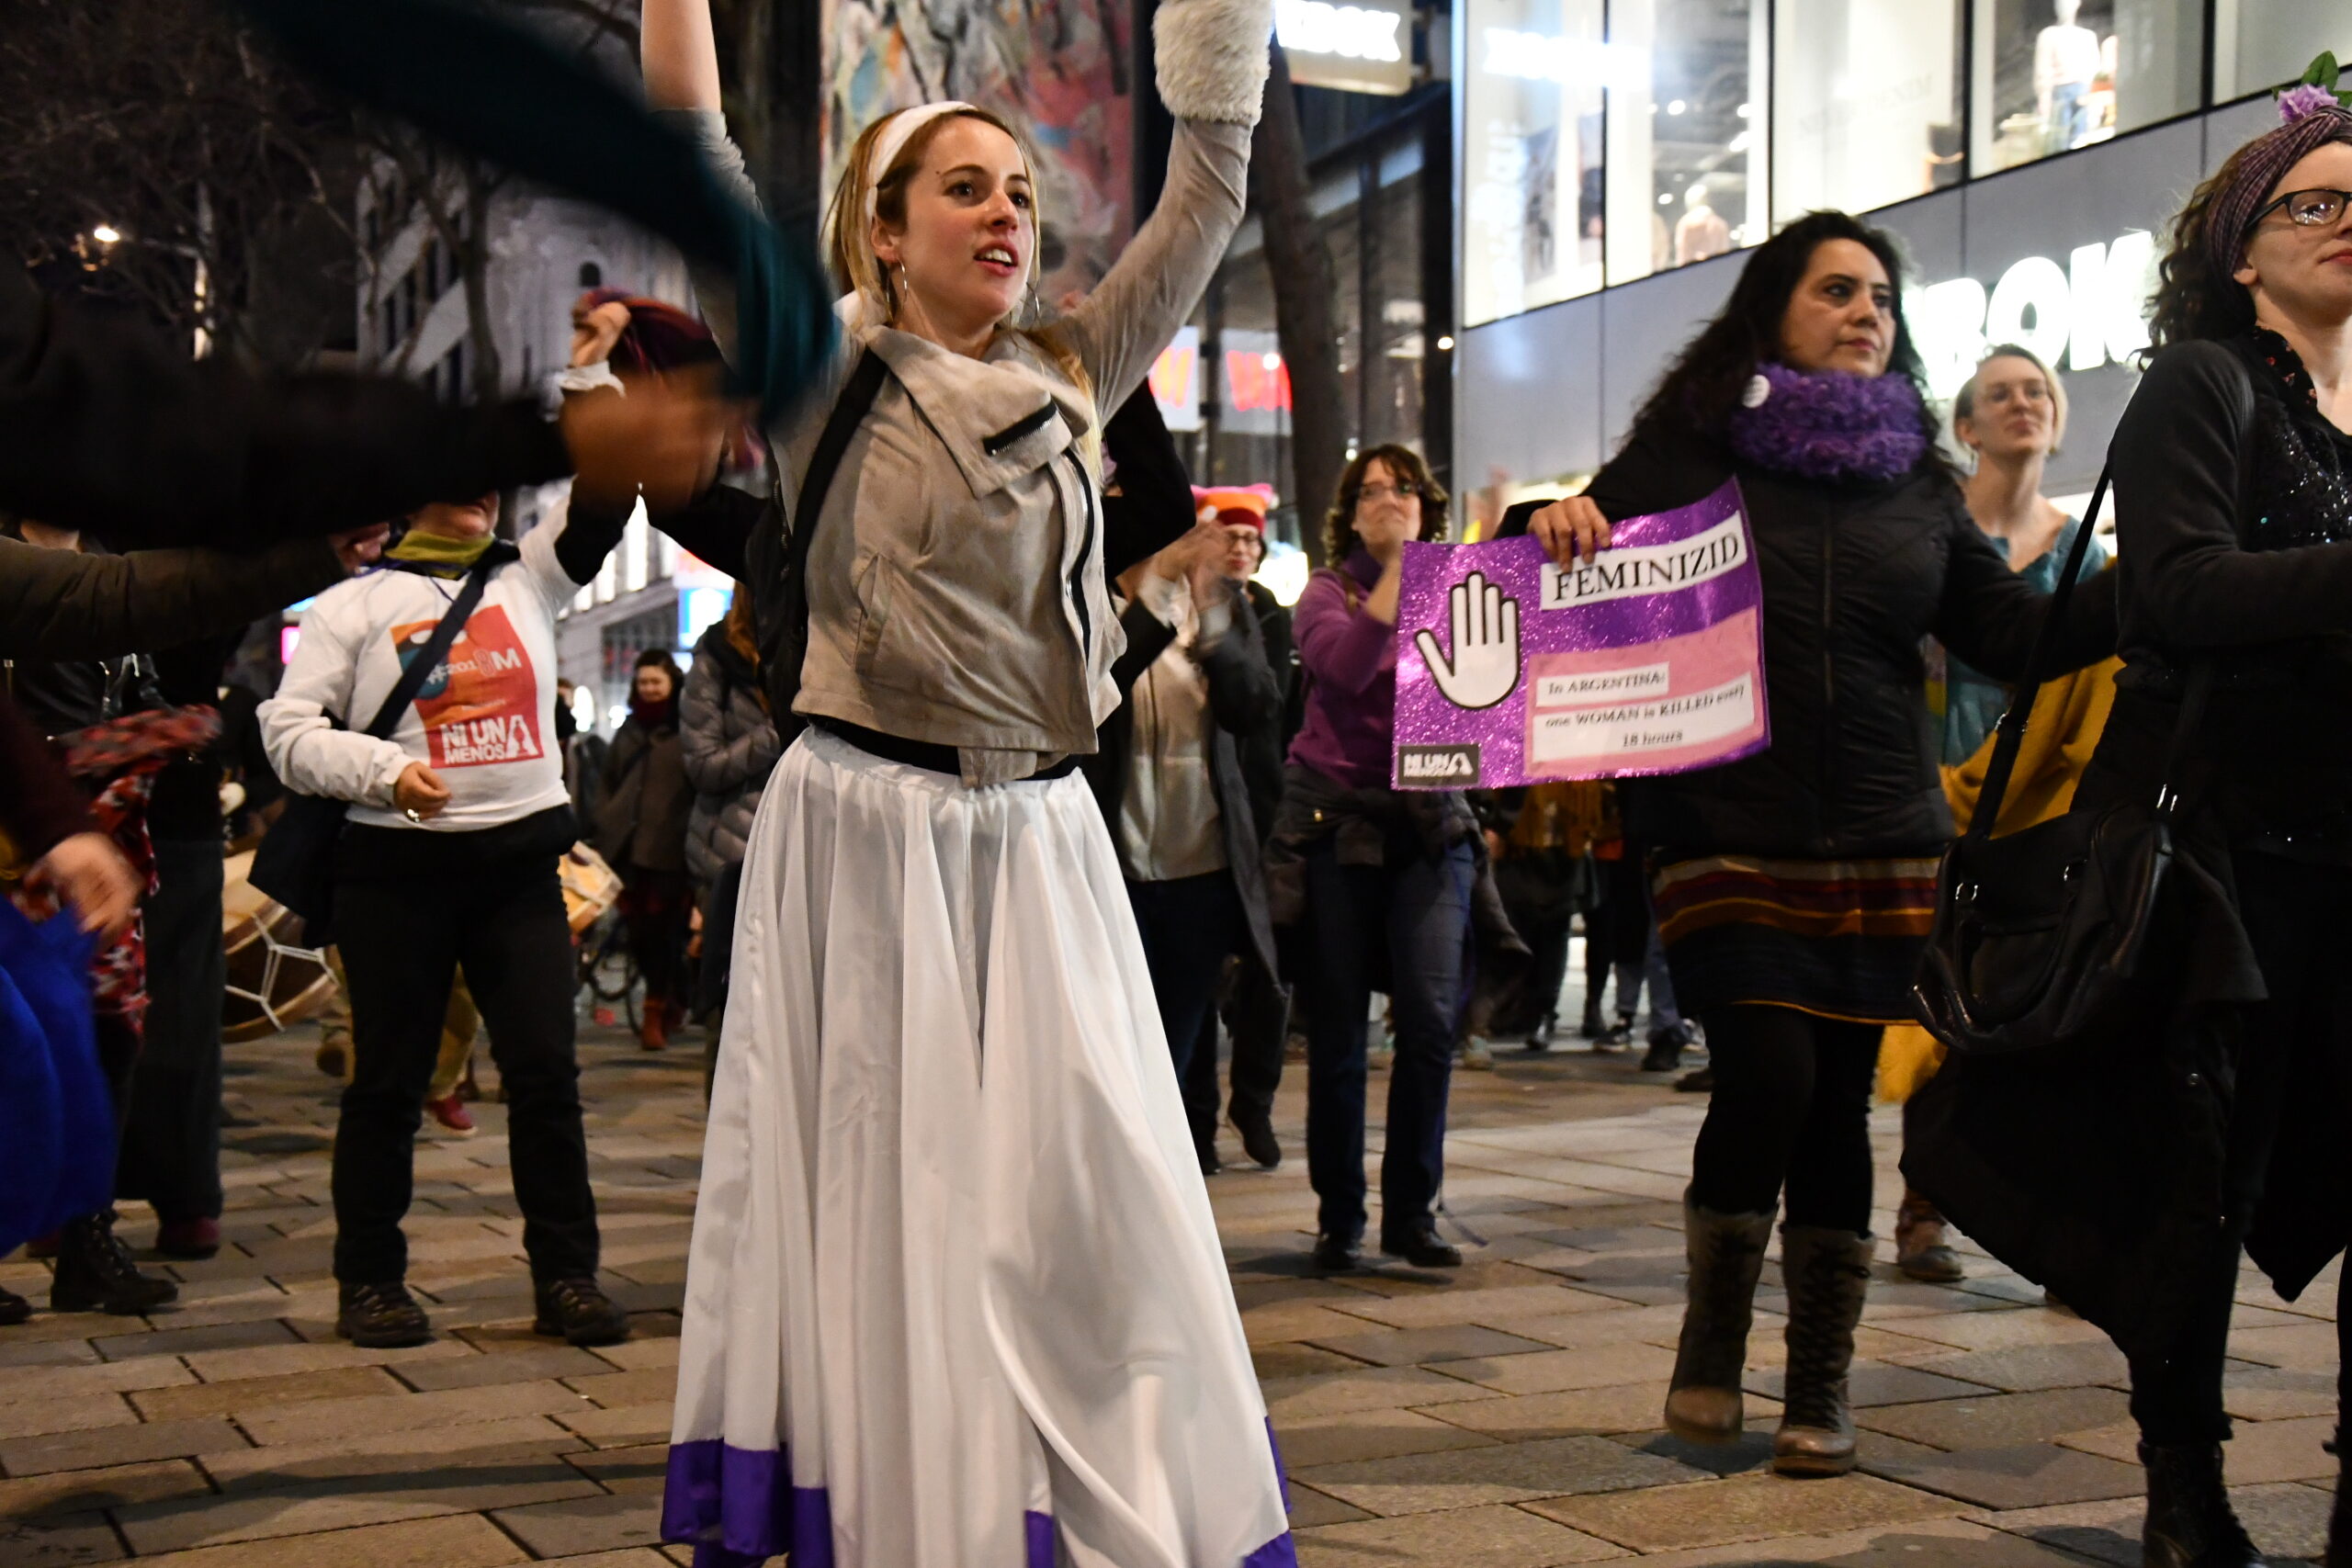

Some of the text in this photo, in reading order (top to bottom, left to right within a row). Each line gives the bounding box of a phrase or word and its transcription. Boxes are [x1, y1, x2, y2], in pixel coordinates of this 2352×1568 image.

[1553, 532, 1739, 602] FEMINIZID
[1545, 716, 1570, 728] one
[1577, 706, 1640, 726] WOMAN
[1660, 694, 1713, 716] KILLED
[439, 722, 469, 749] NI
[1643, 729, 1683, 746] hours
[445, 742, 505, 764] MENOS
